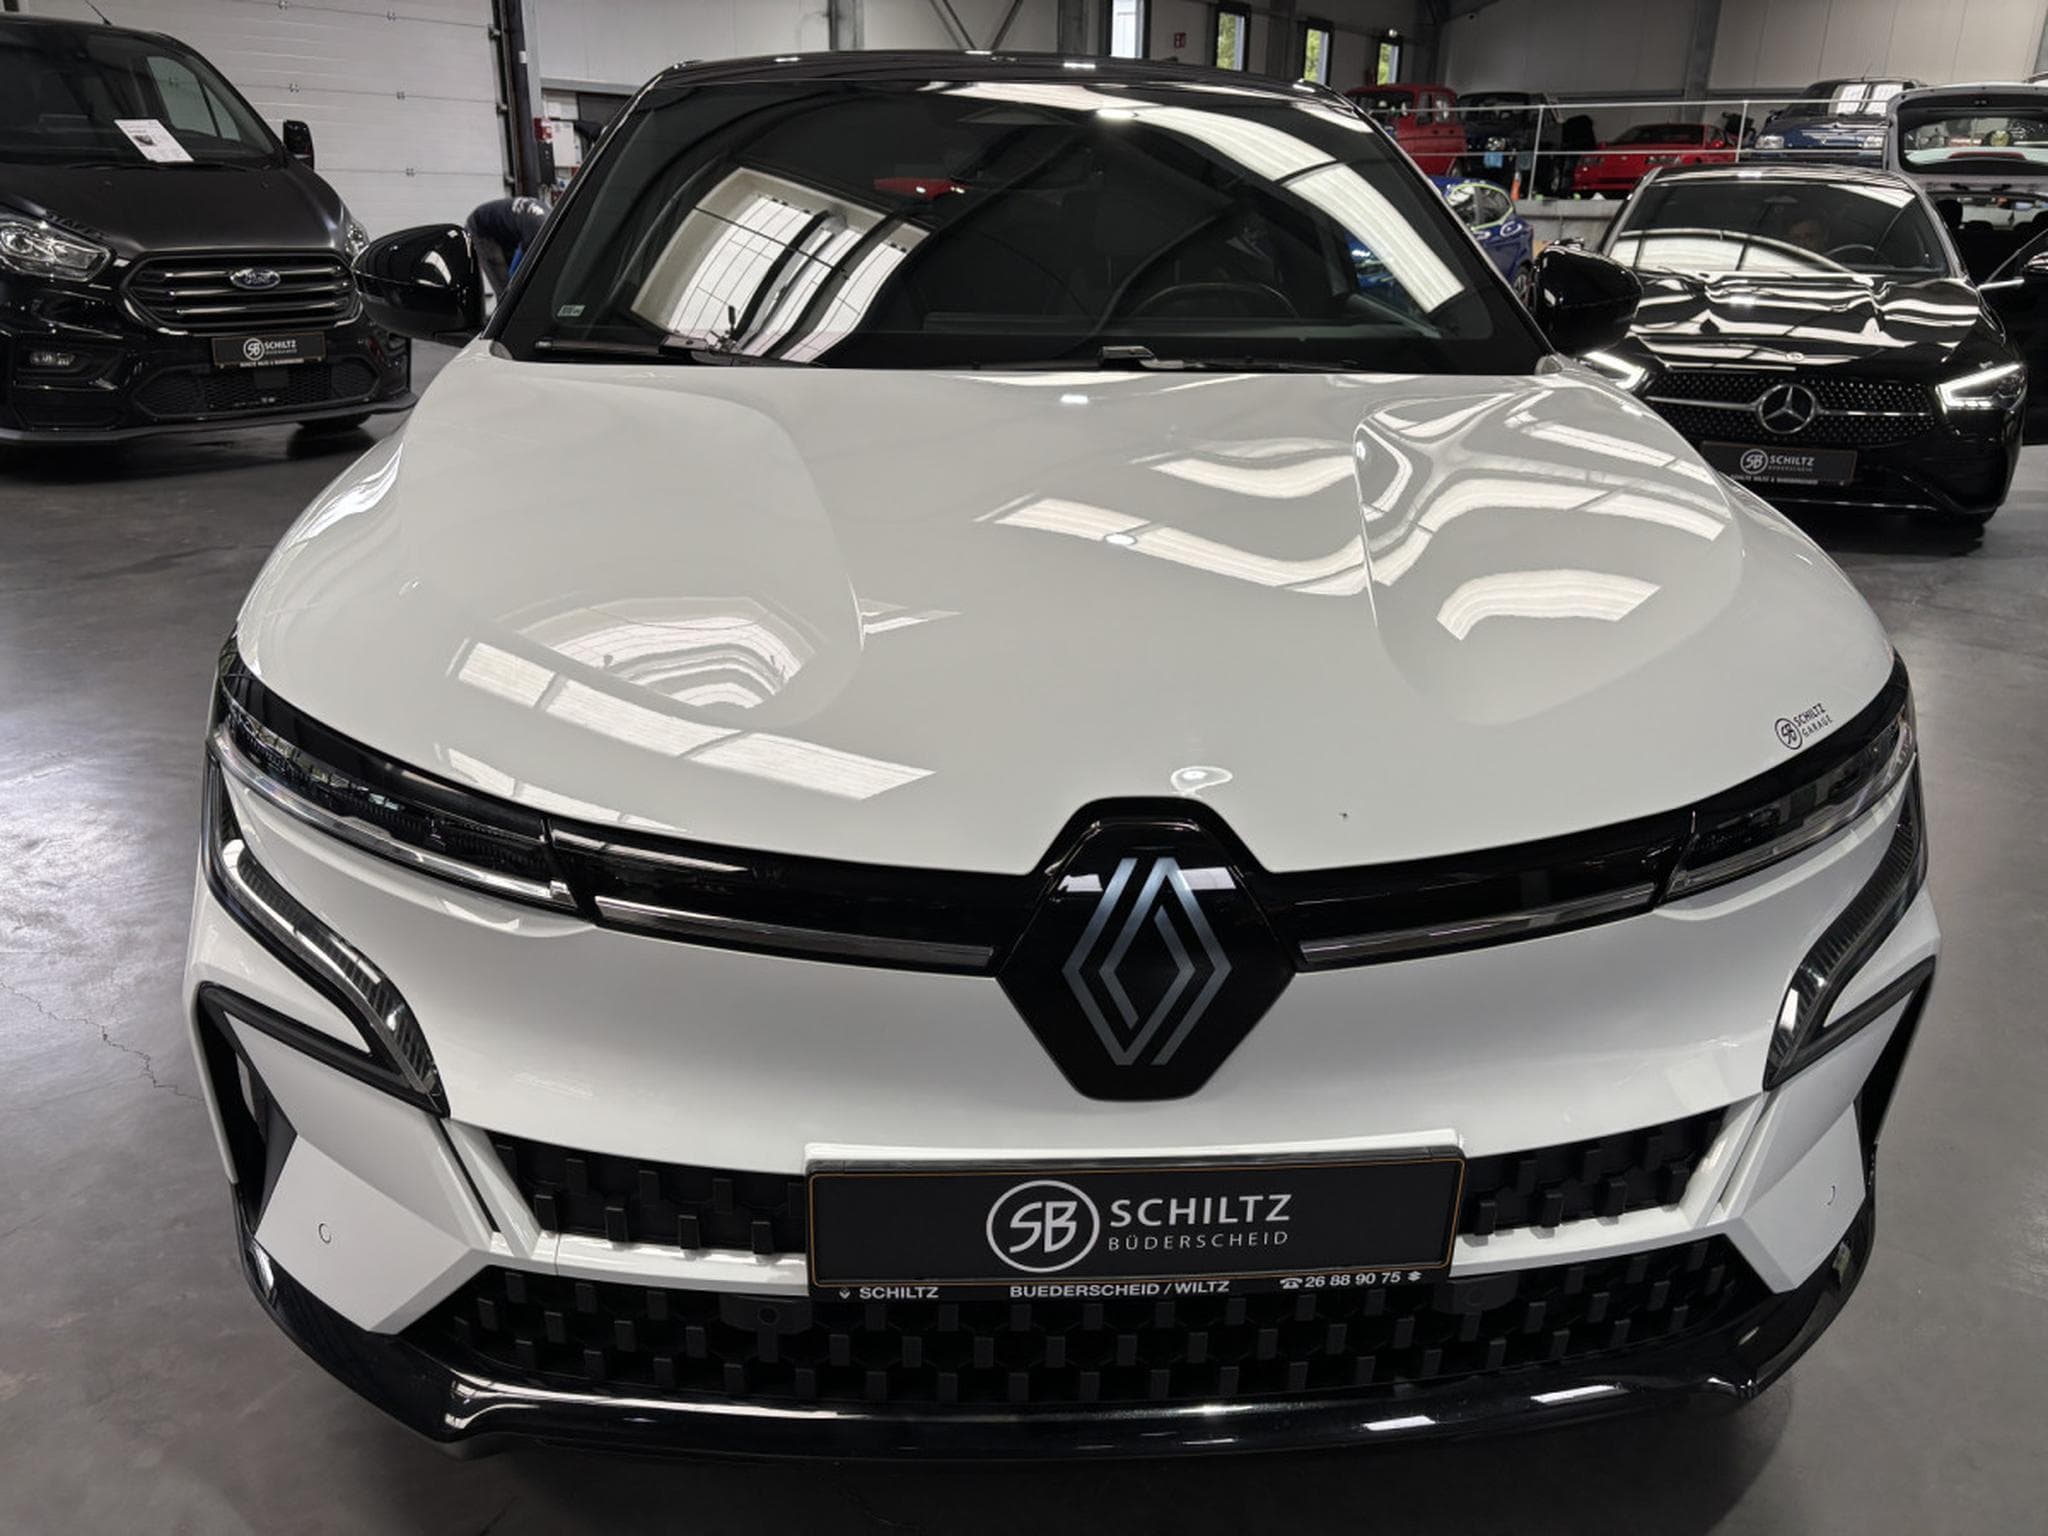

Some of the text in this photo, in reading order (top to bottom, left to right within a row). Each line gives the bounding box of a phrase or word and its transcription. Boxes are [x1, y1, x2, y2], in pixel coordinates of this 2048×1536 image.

[264, 340, 297, 350] SCHILTZ
[1769, 455, 1815, 466] SCHILTZ
[1793, 703, 1826, 728] SCHILTZ
[1802, 714, 1833, 738] GARAGE
[1110, 1194, 1292, 1227] SCHILTZ
[1109, 1231, 1289, 1251] BÜDERSCHEID
[859, 1286, 939, 1299] SCHILTZ
[1010, 1283, 1160, 1298] BUEDERSCHEID
[1304, 1276, 1326, 1288] 26
[1329, 1274, 1351, 1287] 88
[1355, 1272, 1377, 1286] 90
[1381, 1271, 1401, 1284] 75
